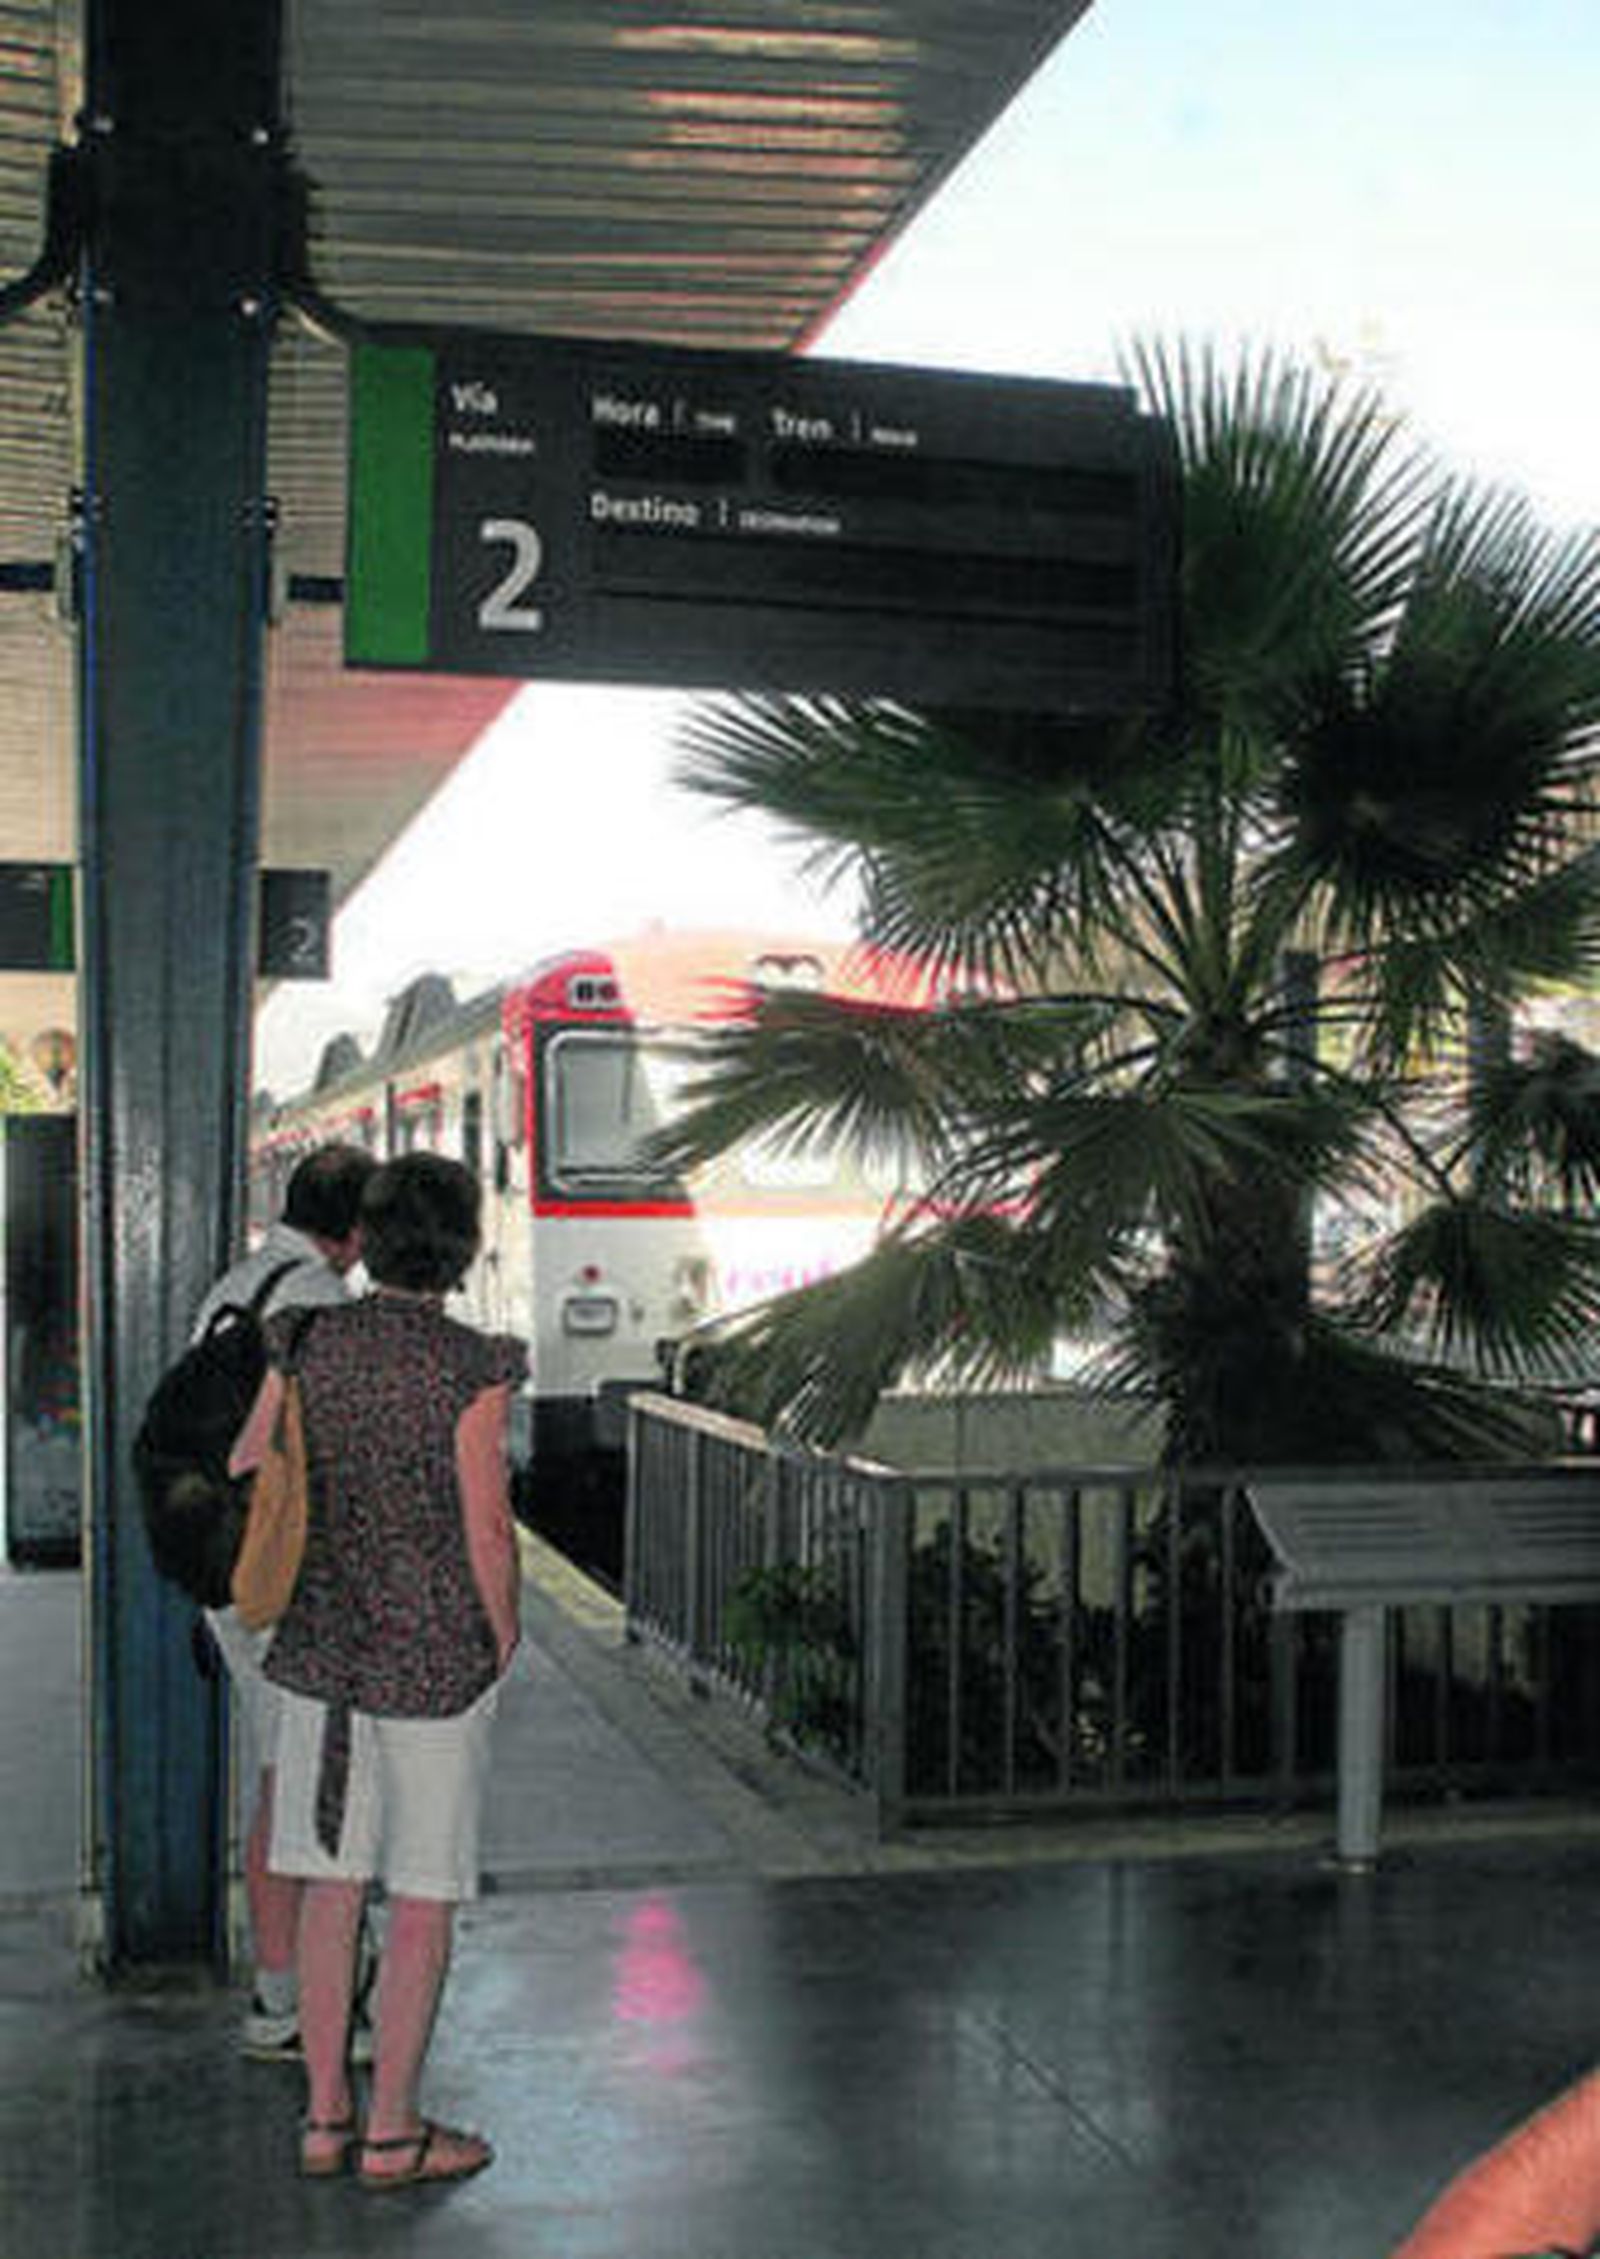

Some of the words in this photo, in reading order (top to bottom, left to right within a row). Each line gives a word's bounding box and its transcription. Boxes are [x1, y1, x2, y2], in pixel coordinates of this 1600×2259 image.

[592, 397, 660, 429] Hora
[772, 405, 833, 441] Tren
[591, 493, 700, 527] Destino
[479, 519, 542, 630] 2
[289, 917, 319, 965] 2
